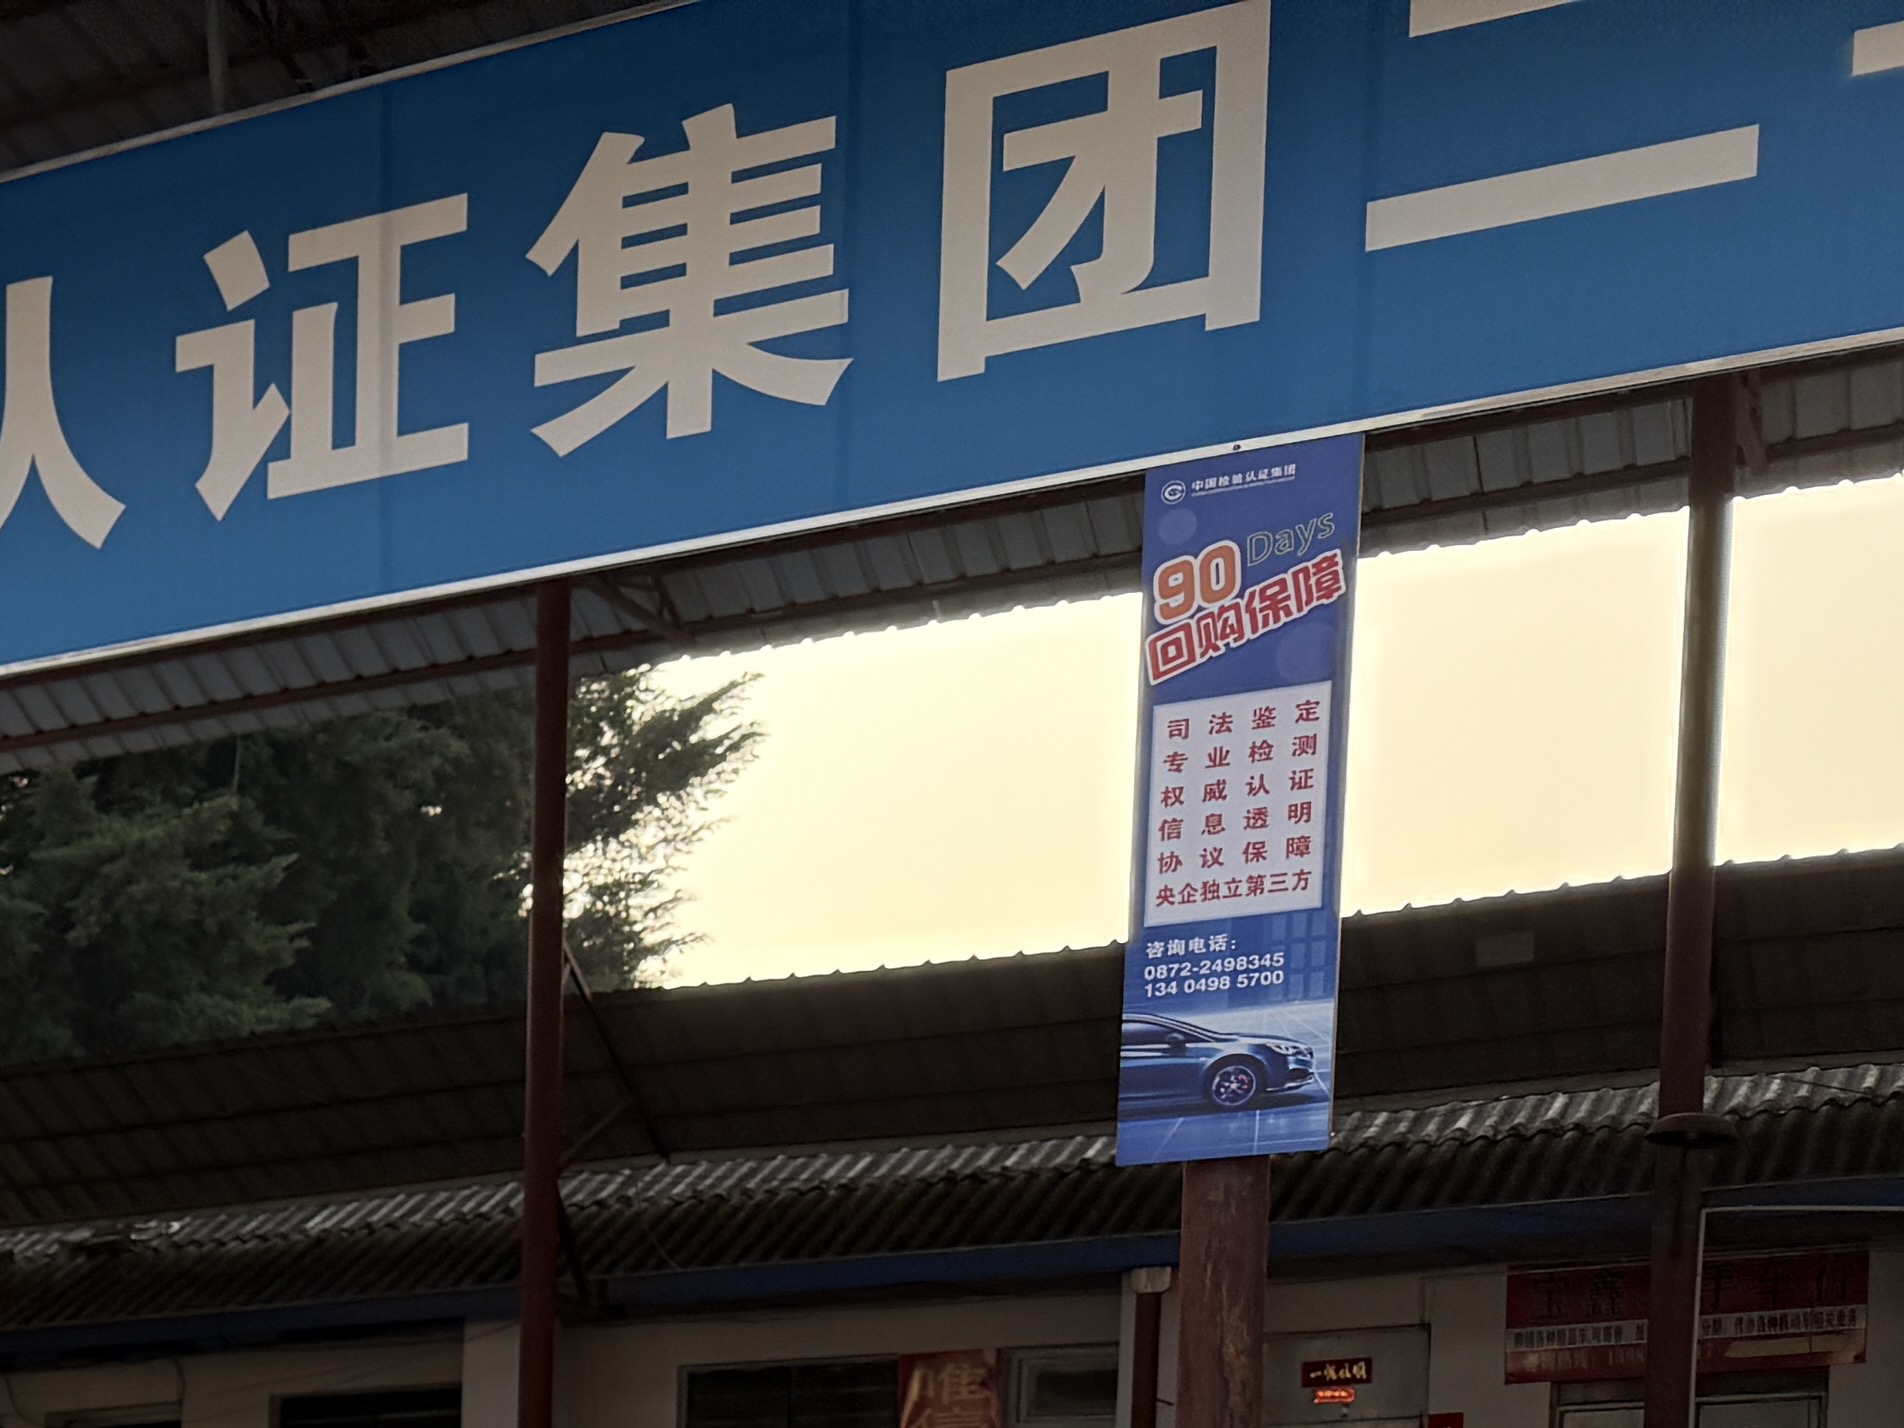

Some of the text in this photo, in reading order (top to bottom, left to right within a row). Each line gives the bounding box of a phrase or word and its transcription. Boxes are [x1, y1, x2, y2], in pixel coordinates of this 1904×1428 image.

[1155, 512, 1335, 625] 90 Days
[1148, 549, 1346, 685] 回购保障
[1167, 699, 1321, 740] 司法鉴定
[1163, 733, 1318, 774] 专业检测
[1160, 768, 1314, 808] 权威认证
[1158, 801, 1312, 842] 信息透明
[1158, 835, 1311, 875] 协议保障
[1156, 868, 1312, 907] 央企独立第三方
[1144, 952, 1285, 981] 0872-2498345
[1144, 970, 1285, 998] 134 0498 5700
